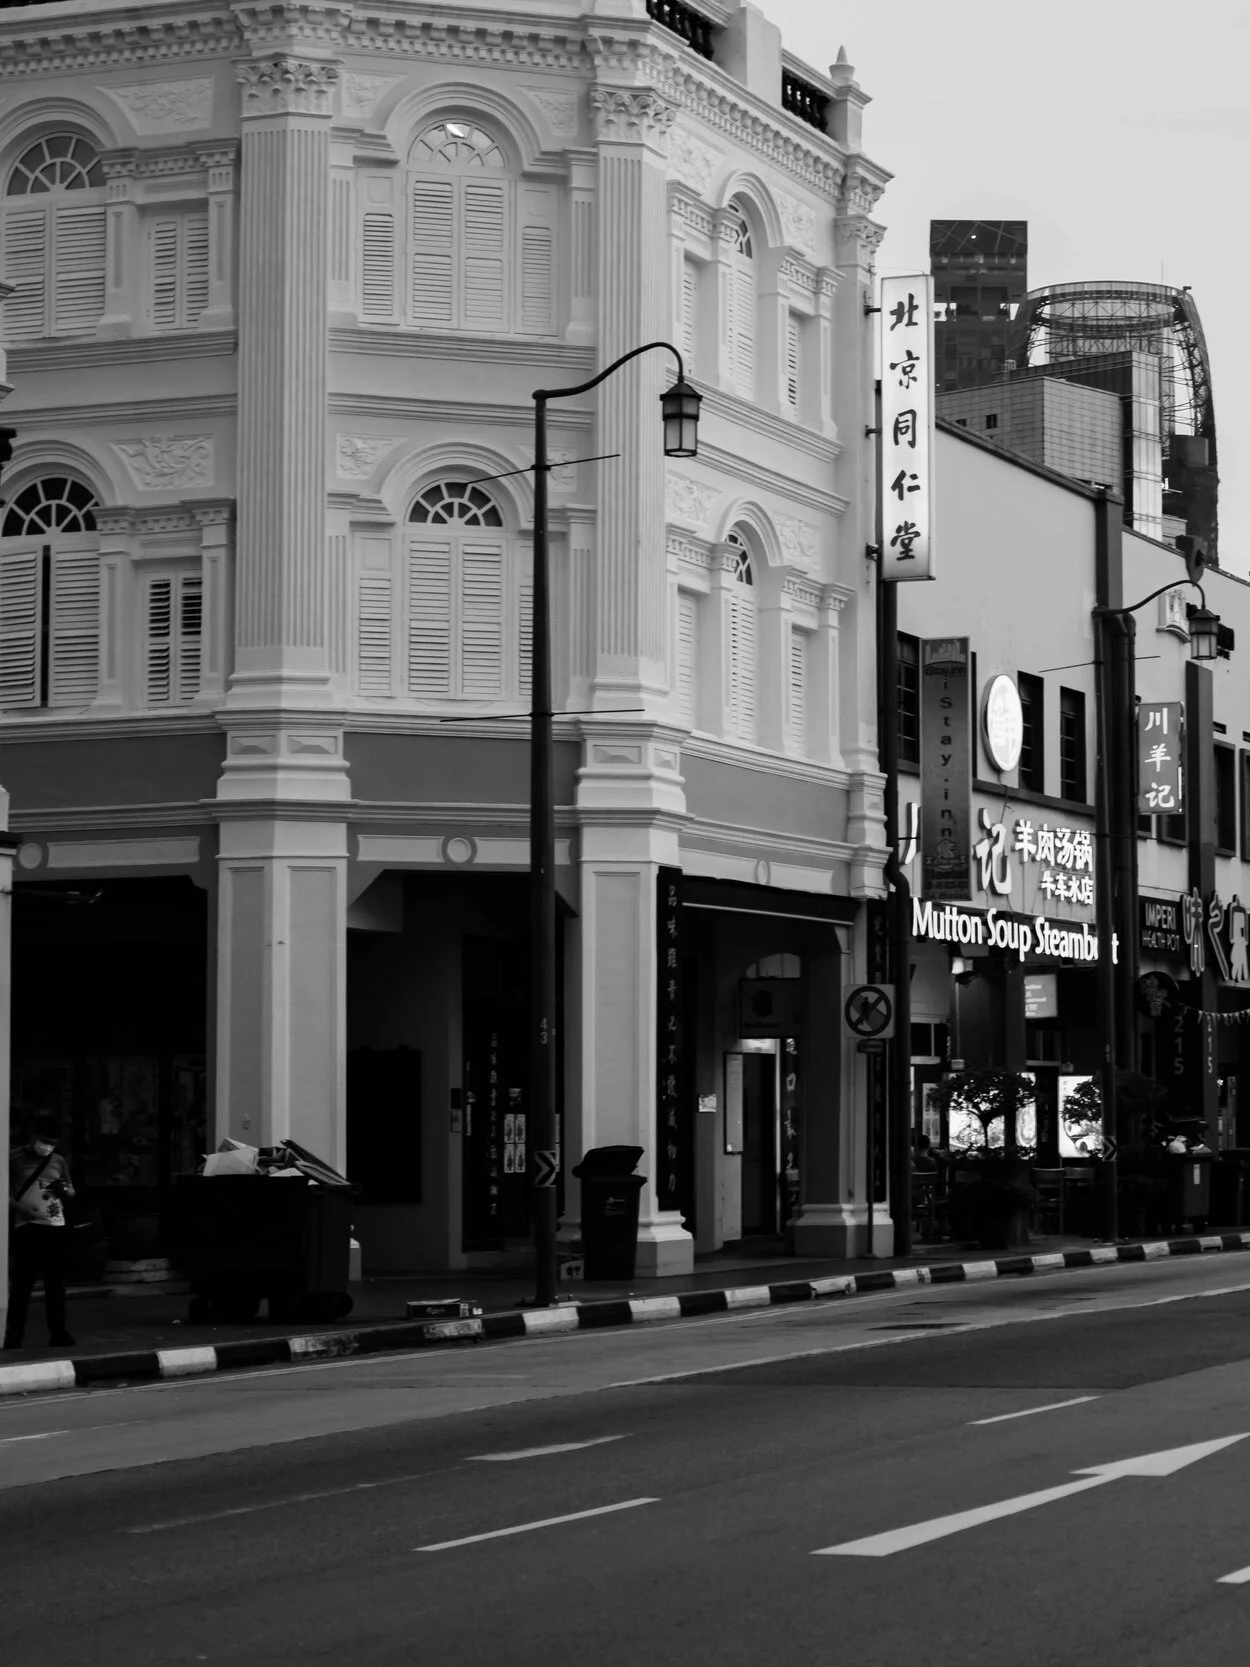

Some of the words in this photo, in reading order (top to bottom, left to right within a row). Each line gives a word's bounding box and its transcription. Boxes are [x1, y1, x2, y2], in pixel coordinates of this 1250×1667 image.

[889, 292, 921, 561] 北京同仁堂
[1144, 707, 1175, 809] 川羊记
[1015, 819, 1093, 872] 羊肉汤锅
[1041, 870, 1094, 904] 牛车水店
[912, 897, 983, 944] Mutton
[987, 908, 1031, 962] Soup
[1035, 916, 1119, 965] Steambt
[540, 1017, 548, 1044] 43
[1173, 1016, 1185, 1075] 215
